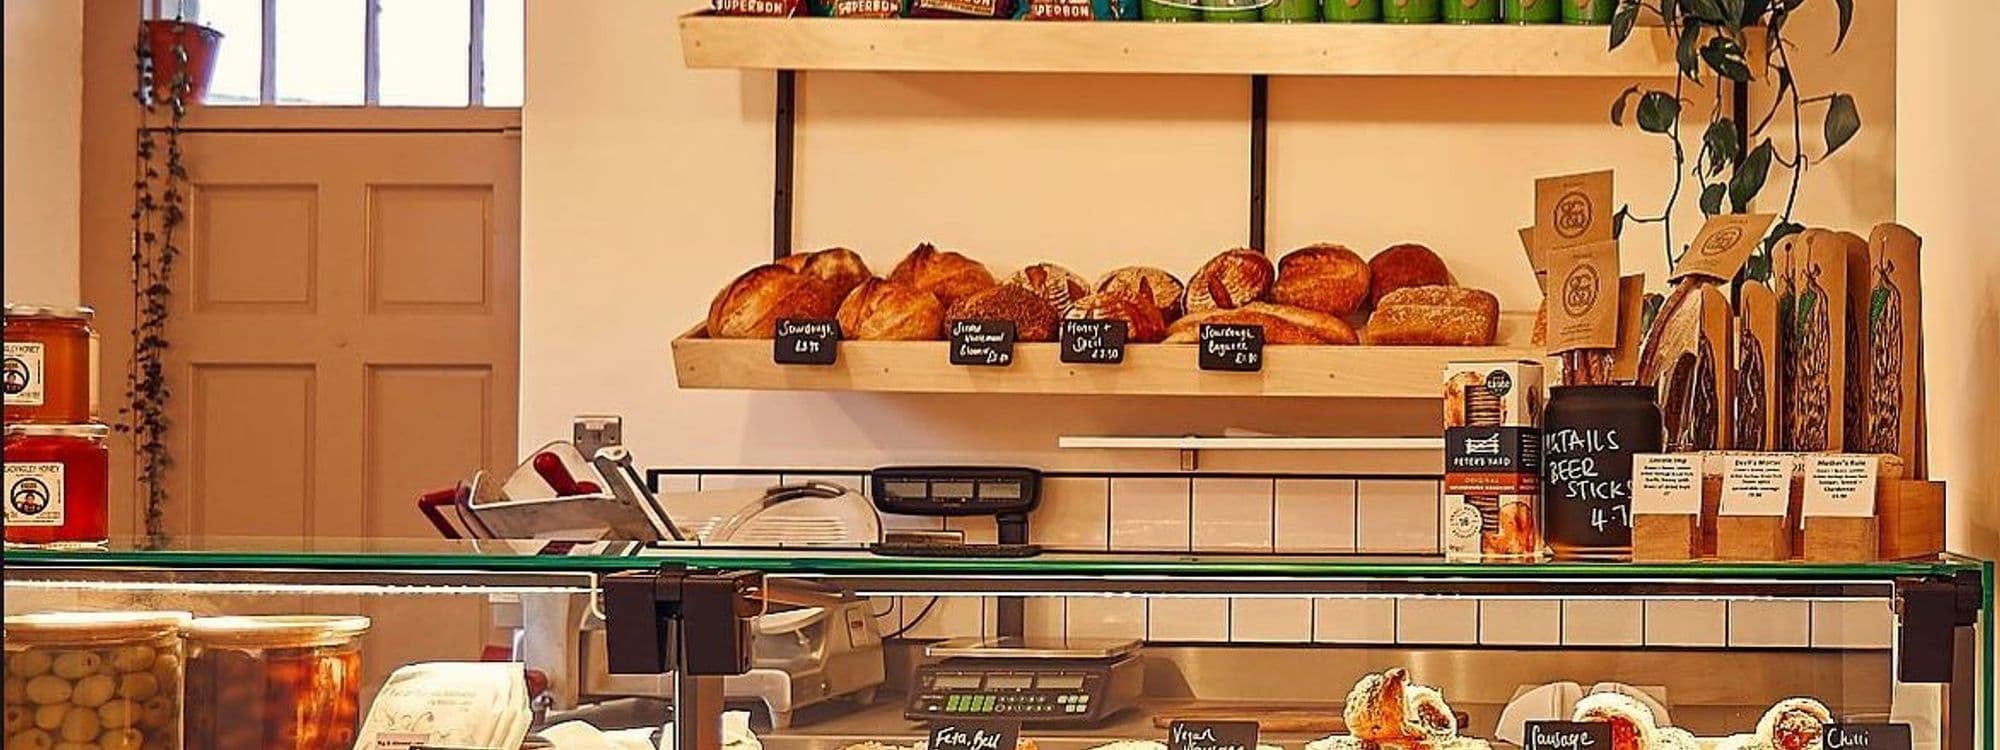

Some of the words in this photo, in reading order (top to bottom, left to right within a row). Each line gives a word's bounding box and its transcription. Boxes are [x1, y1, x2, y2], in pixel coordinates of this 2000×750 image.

[1067, 320, 1100, 340] Honey
[1549, 457, 1598, 484] BEER
[936, 727, 971, 747] Feta,
[971, 730, 1001, 750] Bell
[1531, 725, 1595, 750] Sausage
[1827, 728, 1870, 748] Chilli
